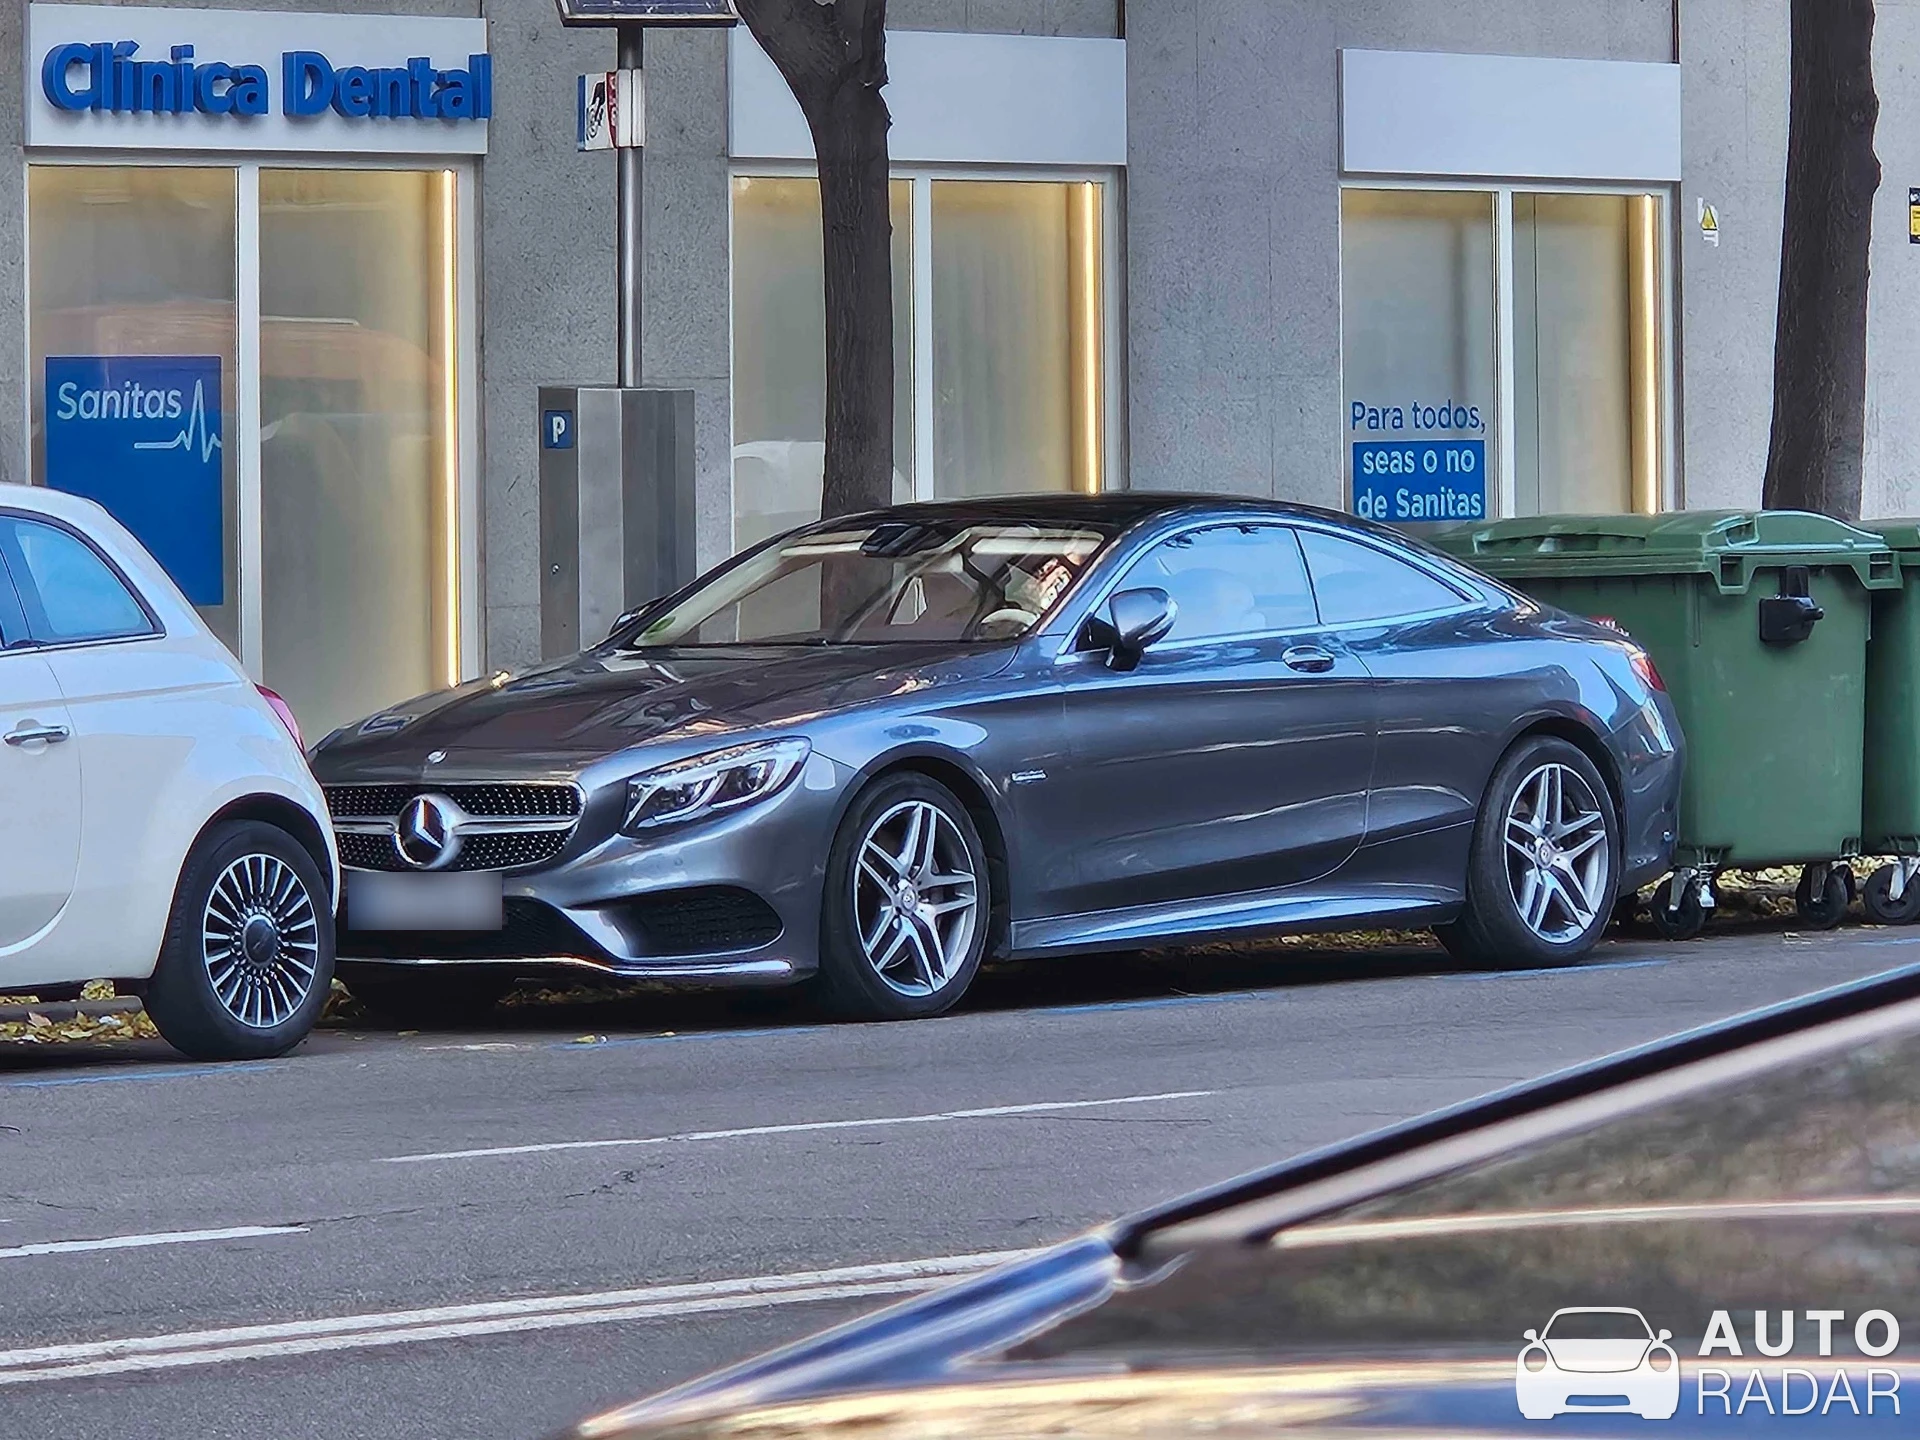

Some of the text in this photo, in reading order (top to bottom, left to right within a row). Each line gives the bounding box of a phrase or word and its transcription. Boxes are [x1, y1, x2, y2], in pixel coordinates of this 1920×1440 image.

[42, 40, 492, 119] Clínica Dental
[56, 380, 183, 420] Sanitas
[1351, 398, 1486, 434] Para todos,
[552, 416, 566, 444] P
[1363, 449, 1475, 474] seas o no
[1358, 486, 1482, 519] de Sanitas
